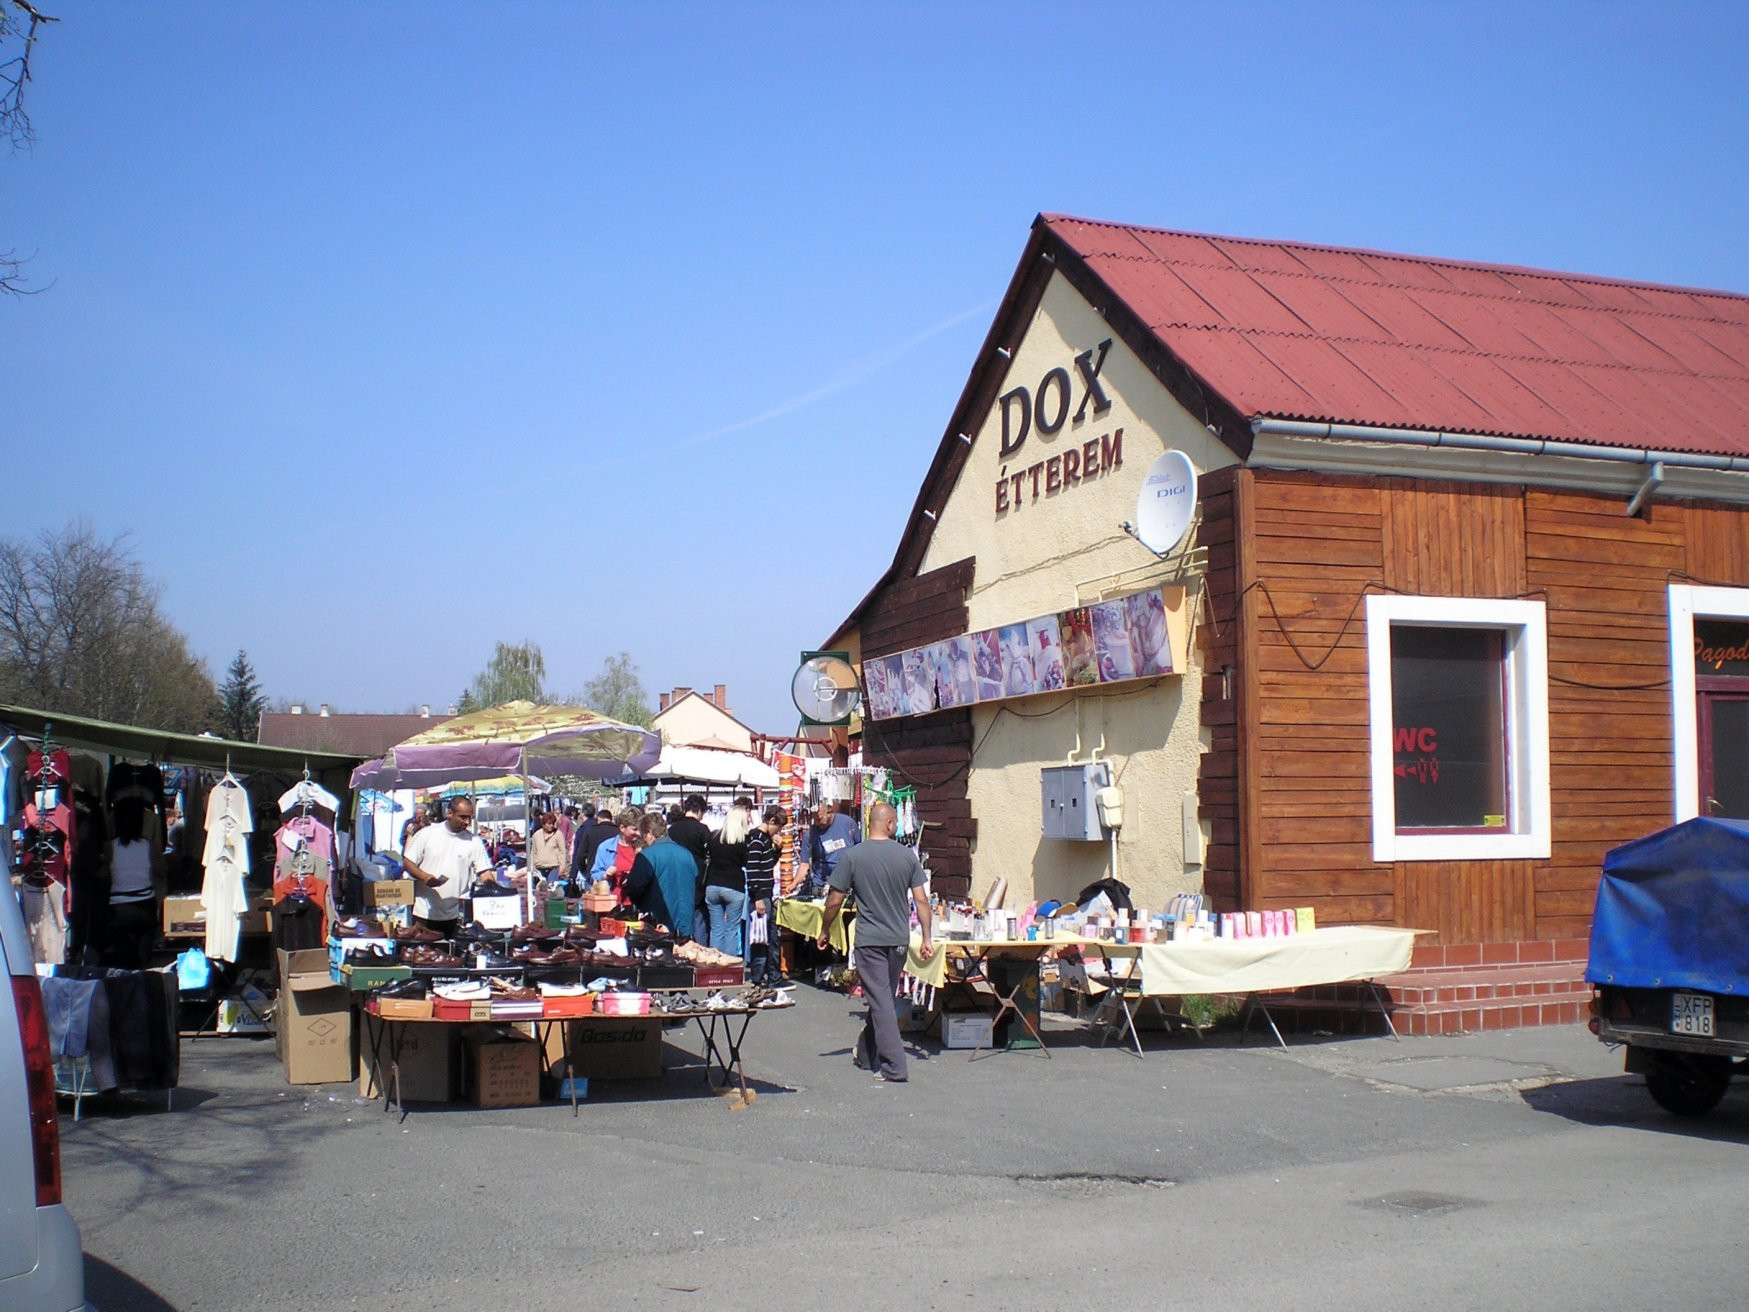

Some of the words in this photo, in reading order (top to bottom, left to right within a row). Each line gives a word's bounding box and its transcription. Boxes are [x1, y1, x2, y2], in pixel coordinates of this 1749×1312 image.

[999, 338, 1112, 458] DOX
[995, 428, 1124, 513] ÉTTEREM
[1157, 485, 1185, 498] DIGI
[1393, 727, 1437, 752] WC
[1683, 996, 1712, 1014] XFP
[1685, 1014, 1711, 1033] 818
